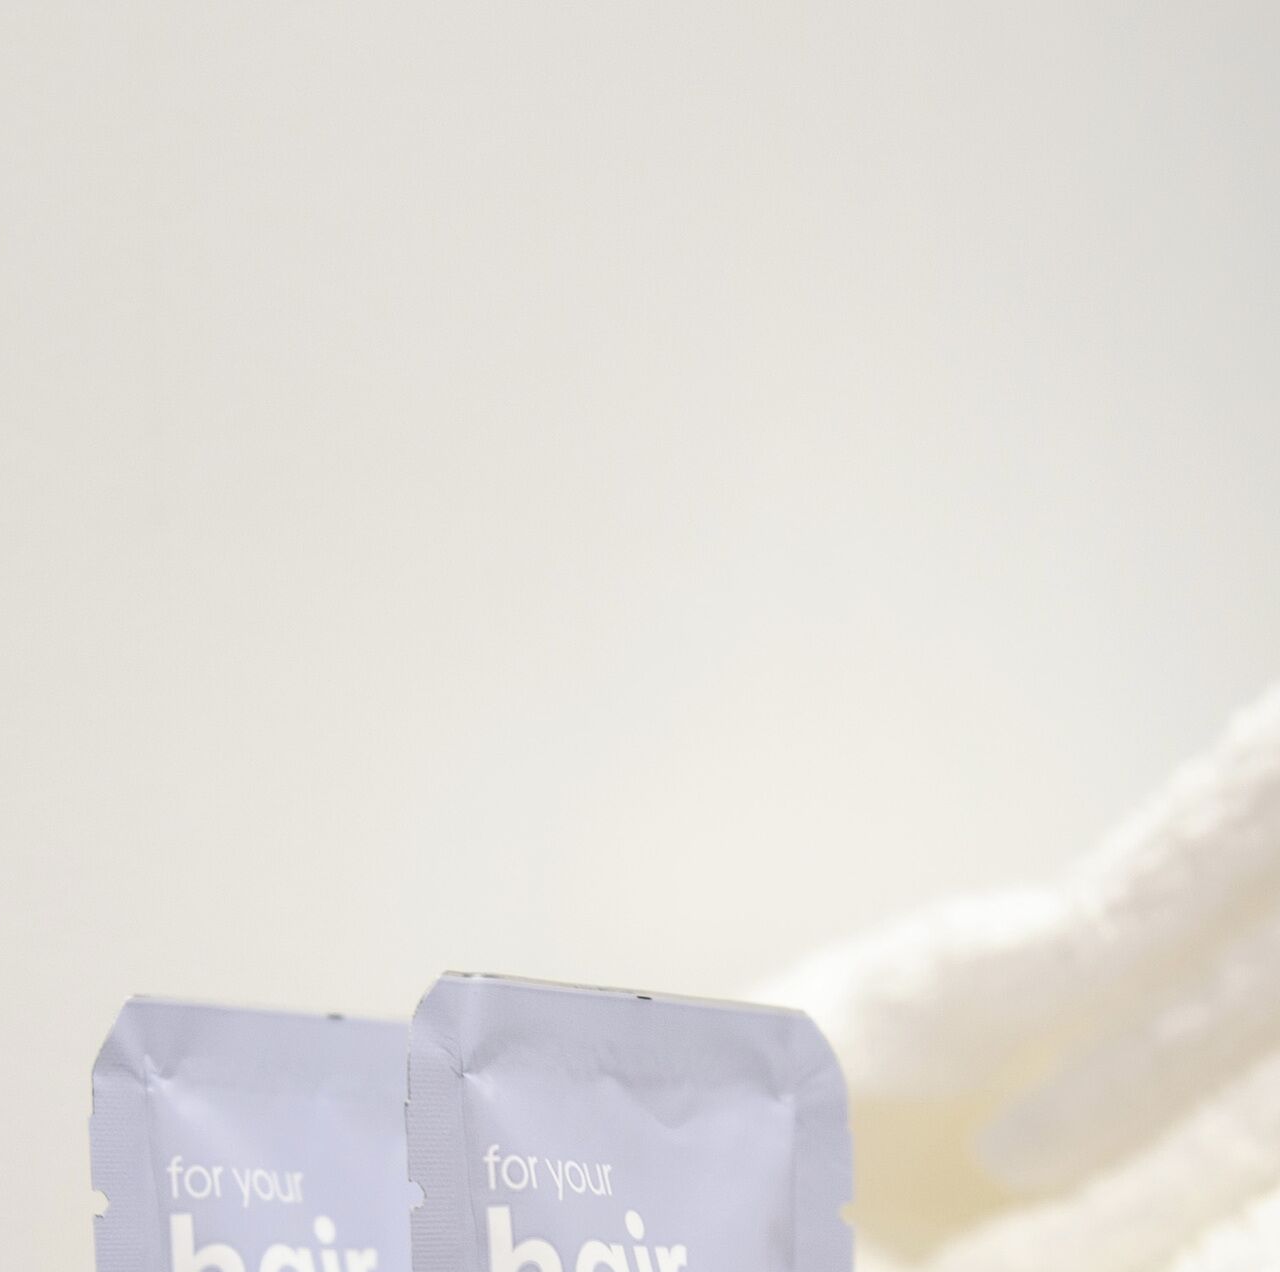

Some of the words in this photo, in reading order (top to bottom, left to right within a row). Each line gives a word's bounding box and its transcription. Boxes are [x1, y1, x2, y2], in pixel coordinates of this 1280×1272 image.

[167, 1155, 222, 1199] for
[232, 1167, 304, 1208] your
[483, 1143, 538, 1191] for
[545, 1156, 612, 1201] your
